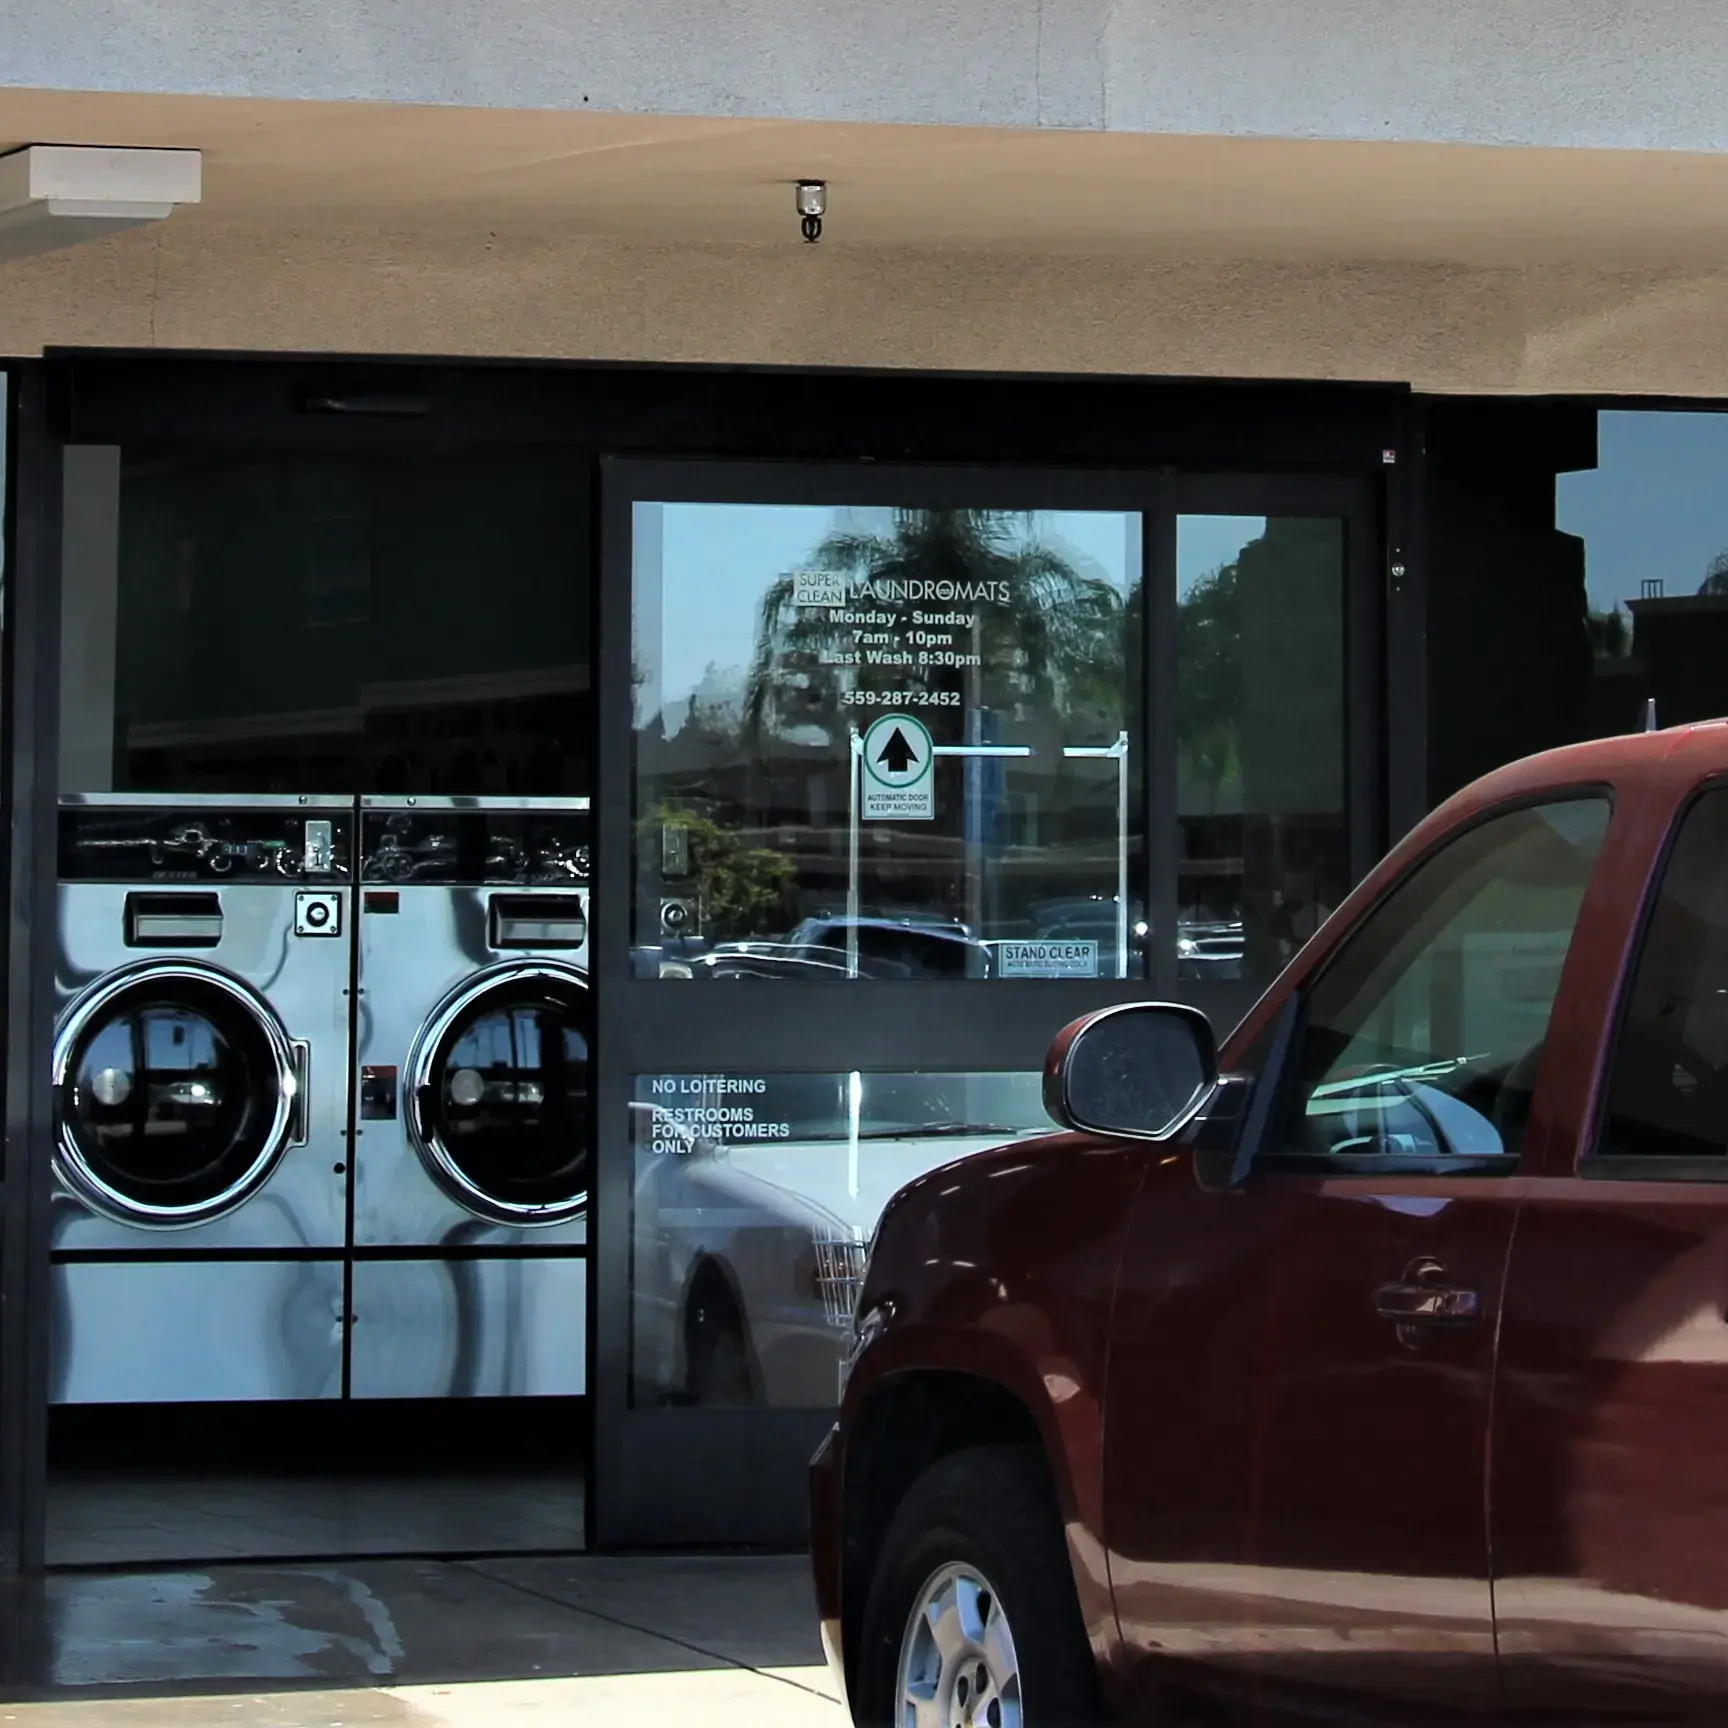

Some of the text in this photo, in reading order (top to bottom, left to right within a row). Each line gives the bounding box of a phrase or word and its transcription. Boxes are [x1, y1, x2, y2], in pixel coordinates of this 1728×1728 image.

[799, 573, 840, 587] SUPER
[797, 589, 843, 604] CLEAN
[849, 579, 1011, 601] LAUNDROMATS
[828, 609, 897, 628] Monday
[912, 610, 976, 629] Sunday
[852, 630, 889, 645] 7am
[905, 630, 953, 648] 10pm
[822, 650, 981, 669] Last Wash 8:30pm
[844, 691, 961, 707] 559-287-2452
[867, 793, 929, 802] AUTOMATIC DOOR
[870, 803, 927, 811] KEEP MOVING
[1005, 946, 1090, 959] STAND CLEAR
[652, 1079, 767, 1094] NO LOITERING
[652, 1107, 755, 1122] RESTROOMS
[689, 1123, 790, 1138] CUSTOMERS
[652, 1139, 695, 1154] ONLY
